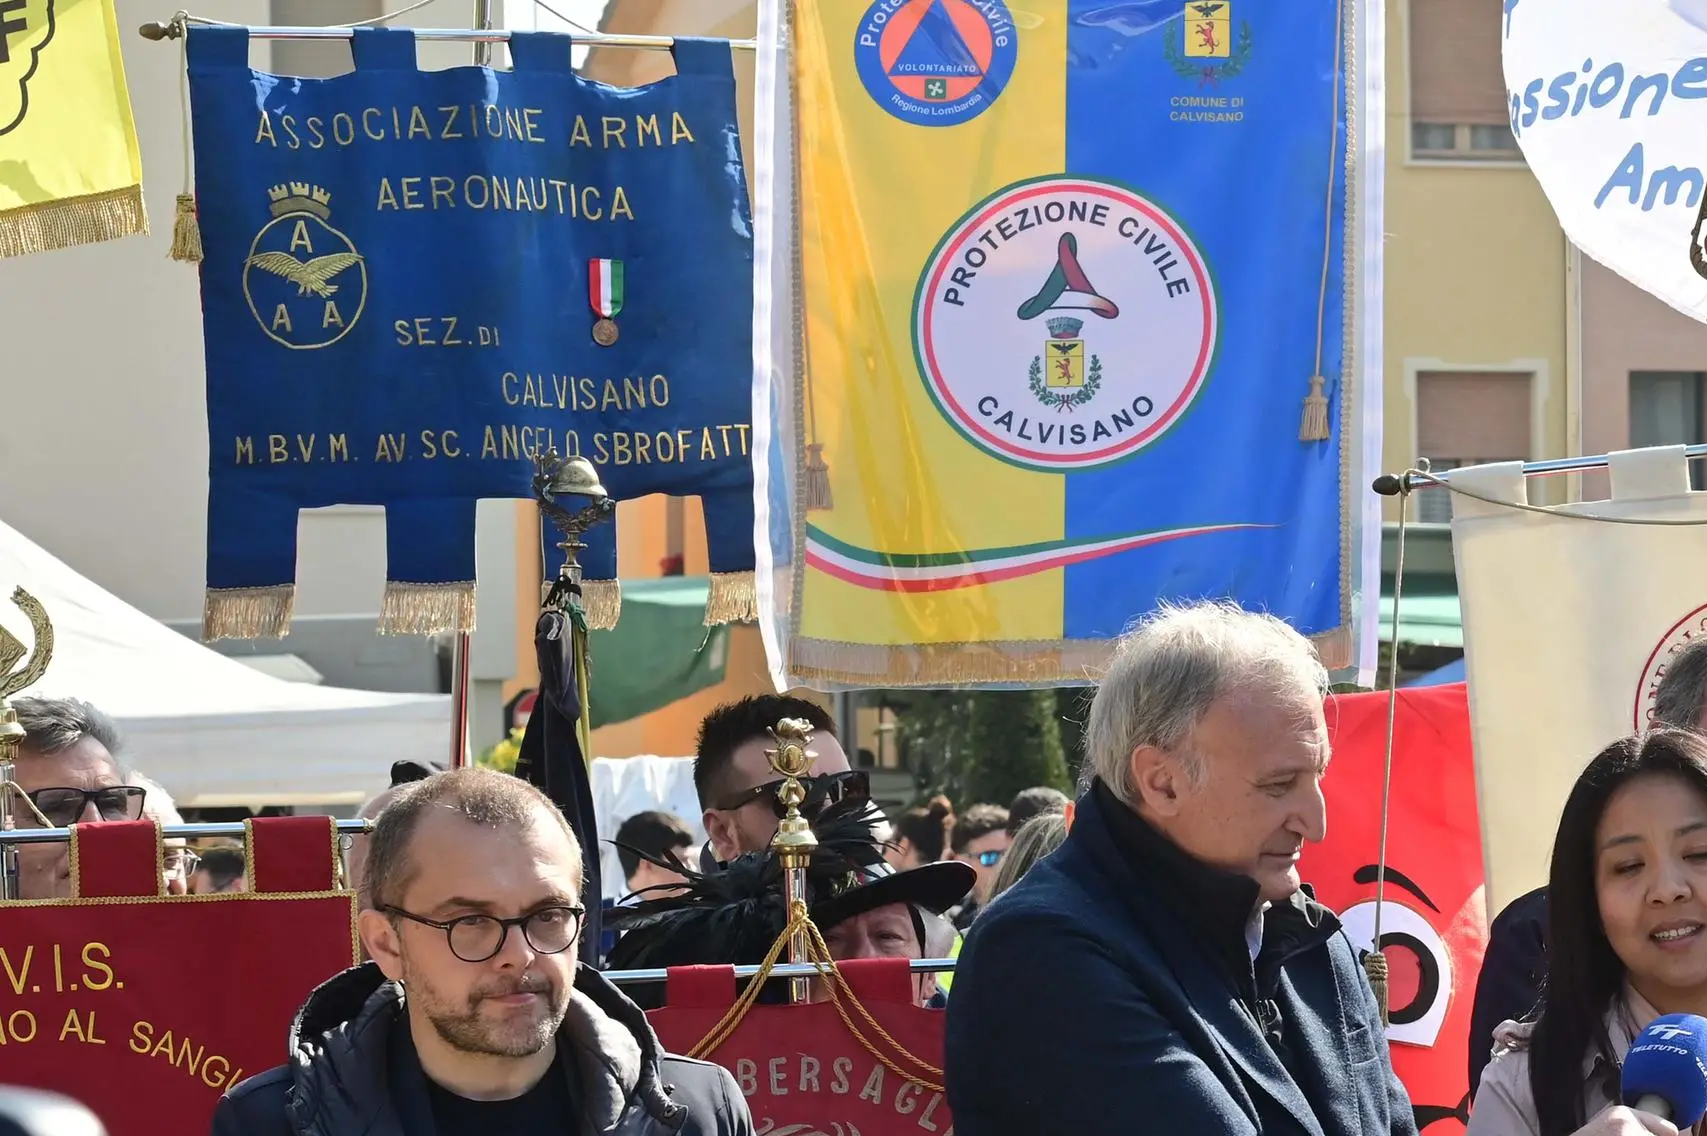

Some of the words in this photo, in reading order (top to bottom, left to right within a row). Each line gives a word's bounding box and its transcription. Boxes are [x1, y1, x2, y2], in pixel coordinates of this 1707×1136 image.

[898, 63, 977, 73] VOLONTARIATO
[891, 94, 931, 116] Regione
[931, 93, 983, 116] Lombardia
[1169, 111, 1244, 122] CALVISANO
[1170, 96, 1227, 108] COMUNE
[1231, 97, 1244, 107] DI
[256, 104, 546, 150] ASSOCIAZIONE
[570, 111, 695, 148] ARMA
[377, 174, 634, 221] AERONAUTICA
[290, 220, 313, 254] A
[943, 200, 1110, 306] PROTEZIONE
[1118, 217, 1190, 298] CIVILE
[273, 303, 292, 332] A
[322, 301, 344, 328] A
[503, 372, 670, 412] CALVISANO
[978, 396, 1154, 445] CALVISANO
[59, 1009, 106, 1044] AL
[1632, 1044, 1688, 1055] TELETUTTO
